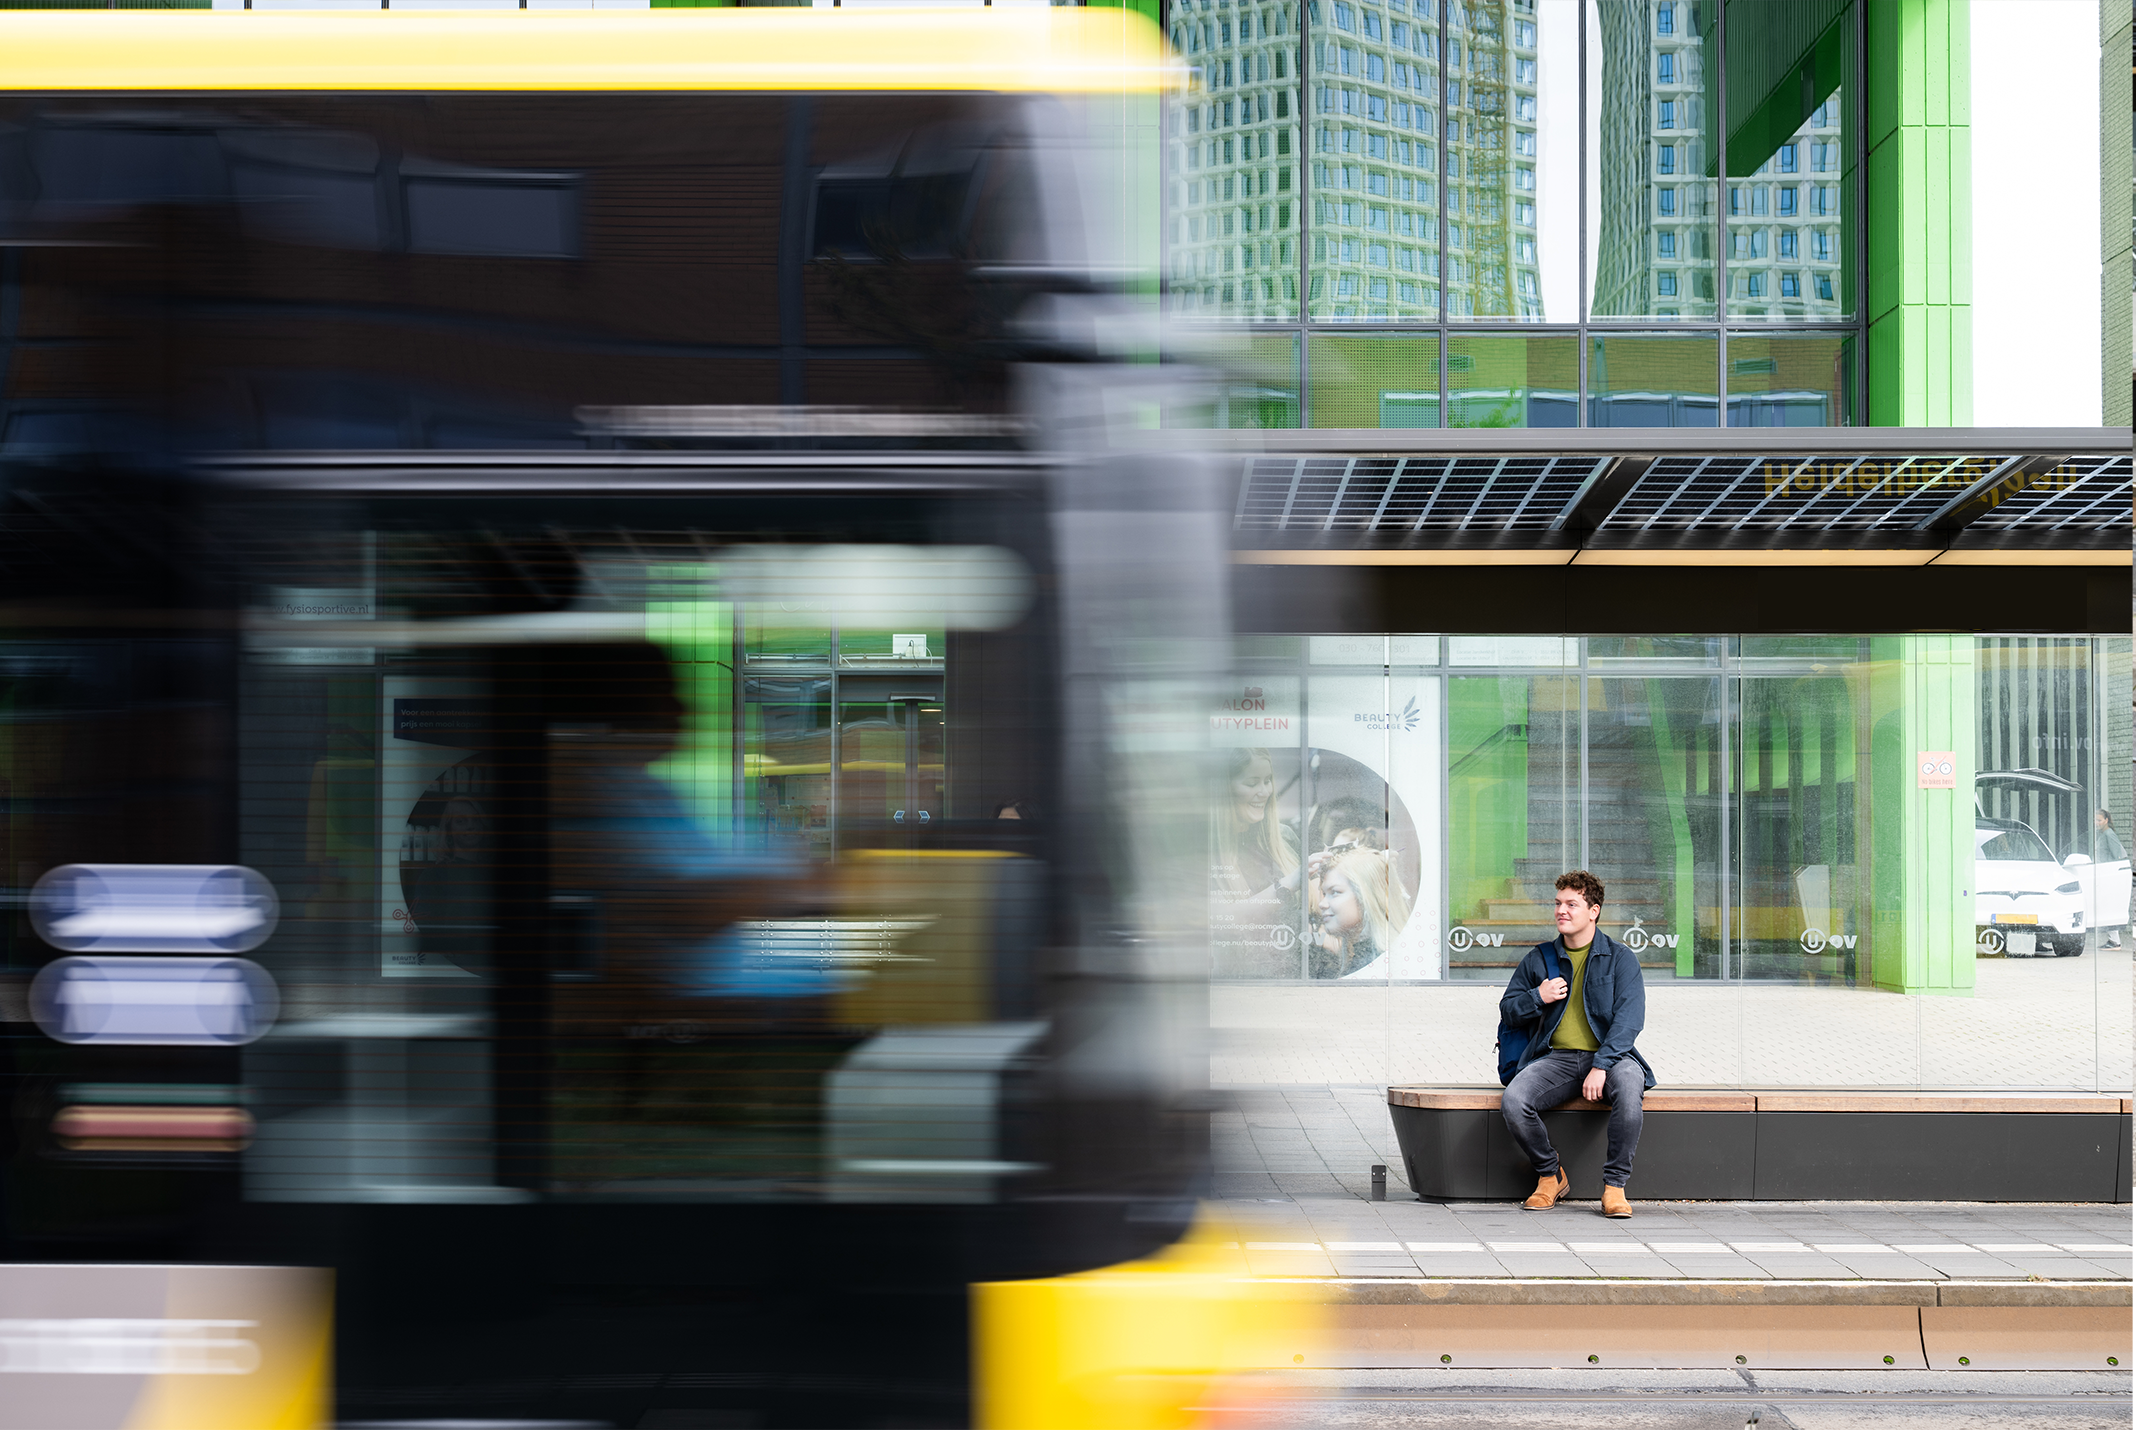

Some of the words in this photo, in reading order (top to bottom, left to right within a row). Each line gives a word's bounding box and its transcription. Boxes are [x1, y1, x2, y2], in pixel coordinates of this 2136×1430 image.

[275, 604, 369, 616] w.fysiosportive.nl
[1354, 713, 1401, 722] BEAUTY
[400, 720, 418, 729] prijs
[1210, 717, 1289, 730] UTYPLEIN
